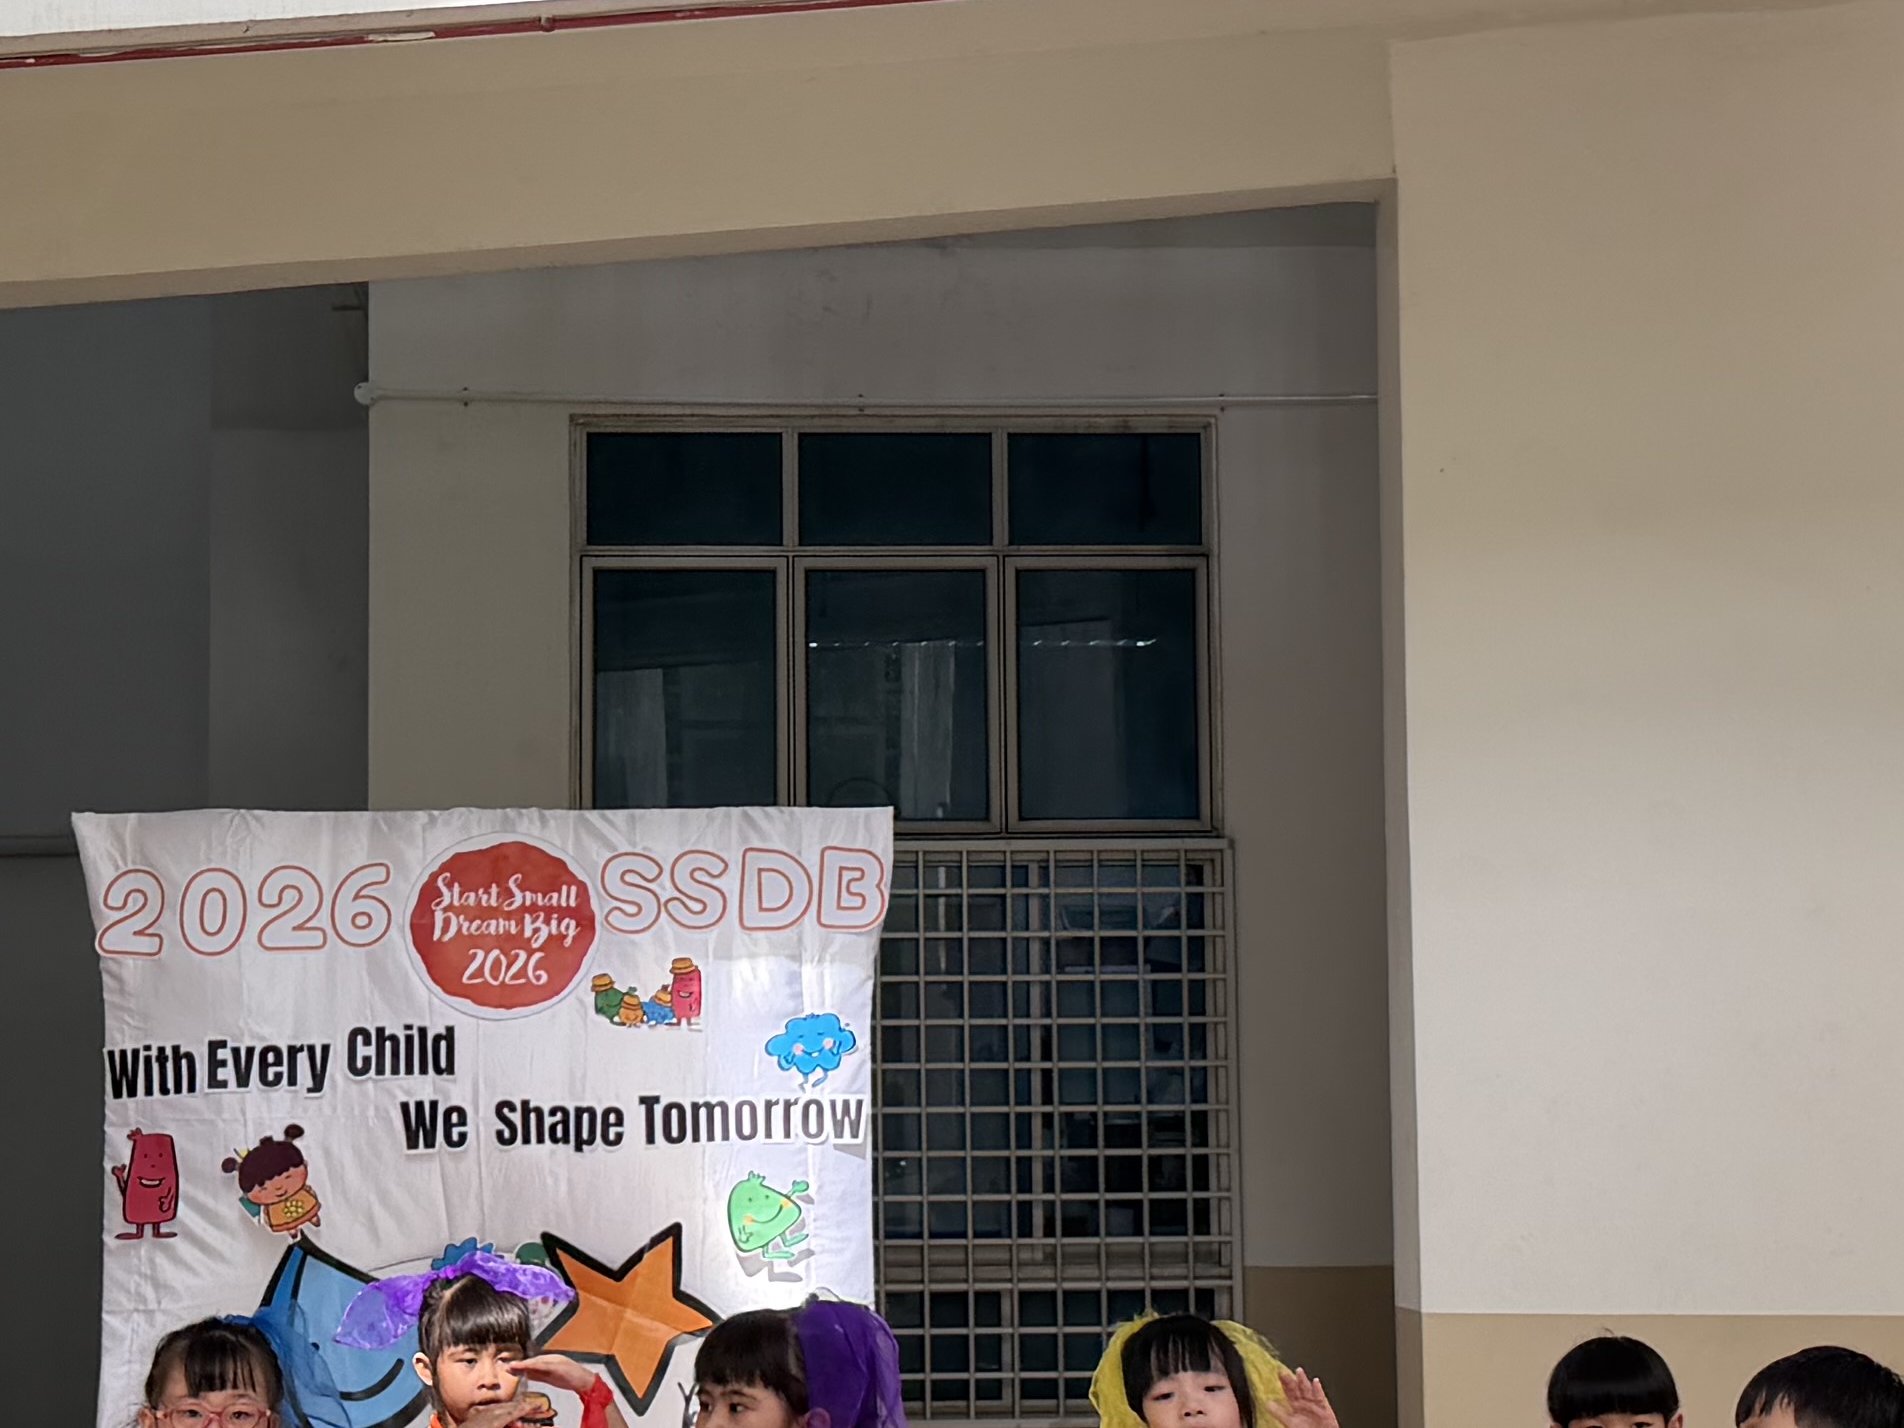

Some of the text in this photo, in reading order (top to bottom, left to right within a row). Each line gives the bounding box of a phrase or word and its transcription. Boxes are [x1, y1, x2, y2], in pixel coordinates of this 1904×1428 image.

[98, 862, 392, 956] 2026
[431, 872, 579, 911] Start Small
[600, 846, 885, 934] SSDB
[433, 909, 580, 949] Dream Big
[462, 949, 548, 985] 2026
[107, 1024, 455, 1099] With Every Child
[400, 1094, 864, 1152] We Shape Tomorrow
